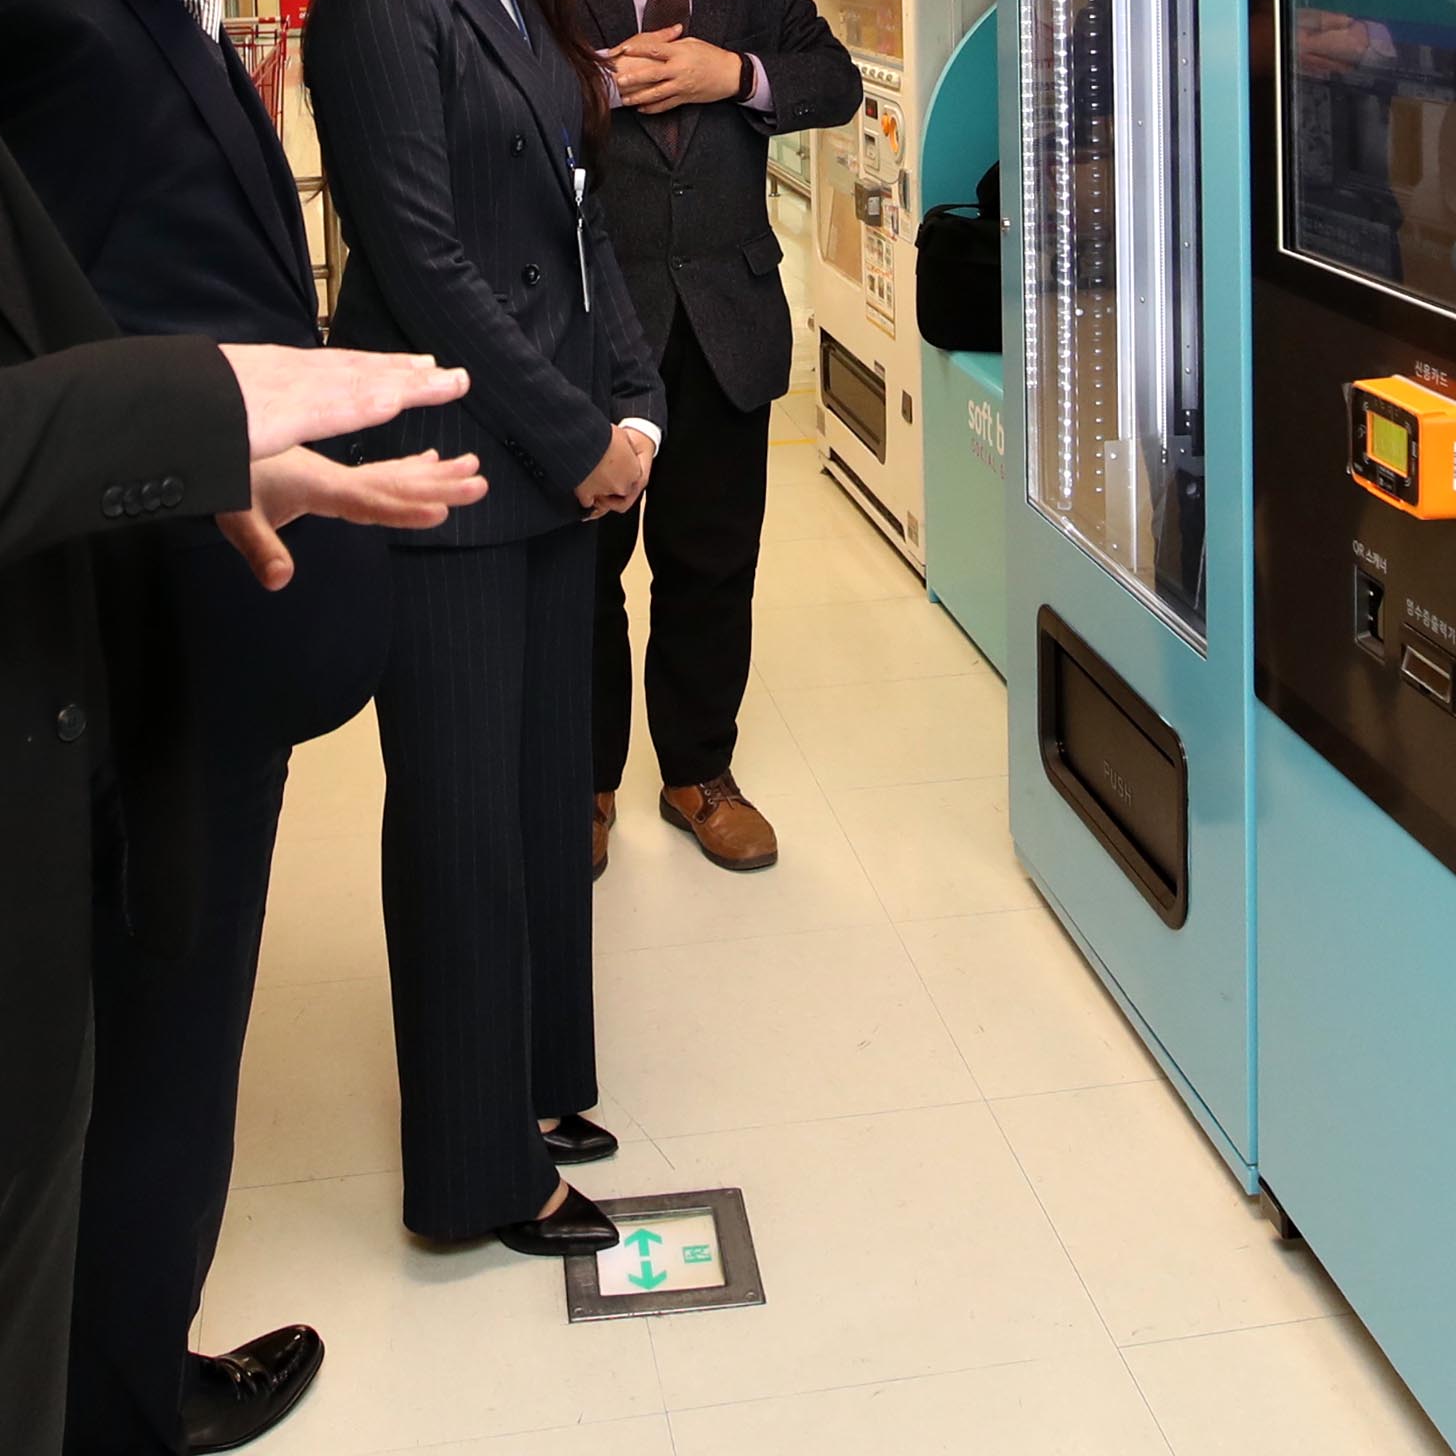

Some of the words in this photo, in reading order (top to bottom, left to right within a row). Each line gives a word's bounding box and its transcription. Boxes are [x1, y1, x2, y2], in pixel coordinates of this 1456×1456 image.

[1414, 360, 1449, 387] 신용카드
[968, 399, 993, 447] soft
[1352, 539, 1365, 559] QR
[1406, 598, 1456, 645] 영수증출력기
